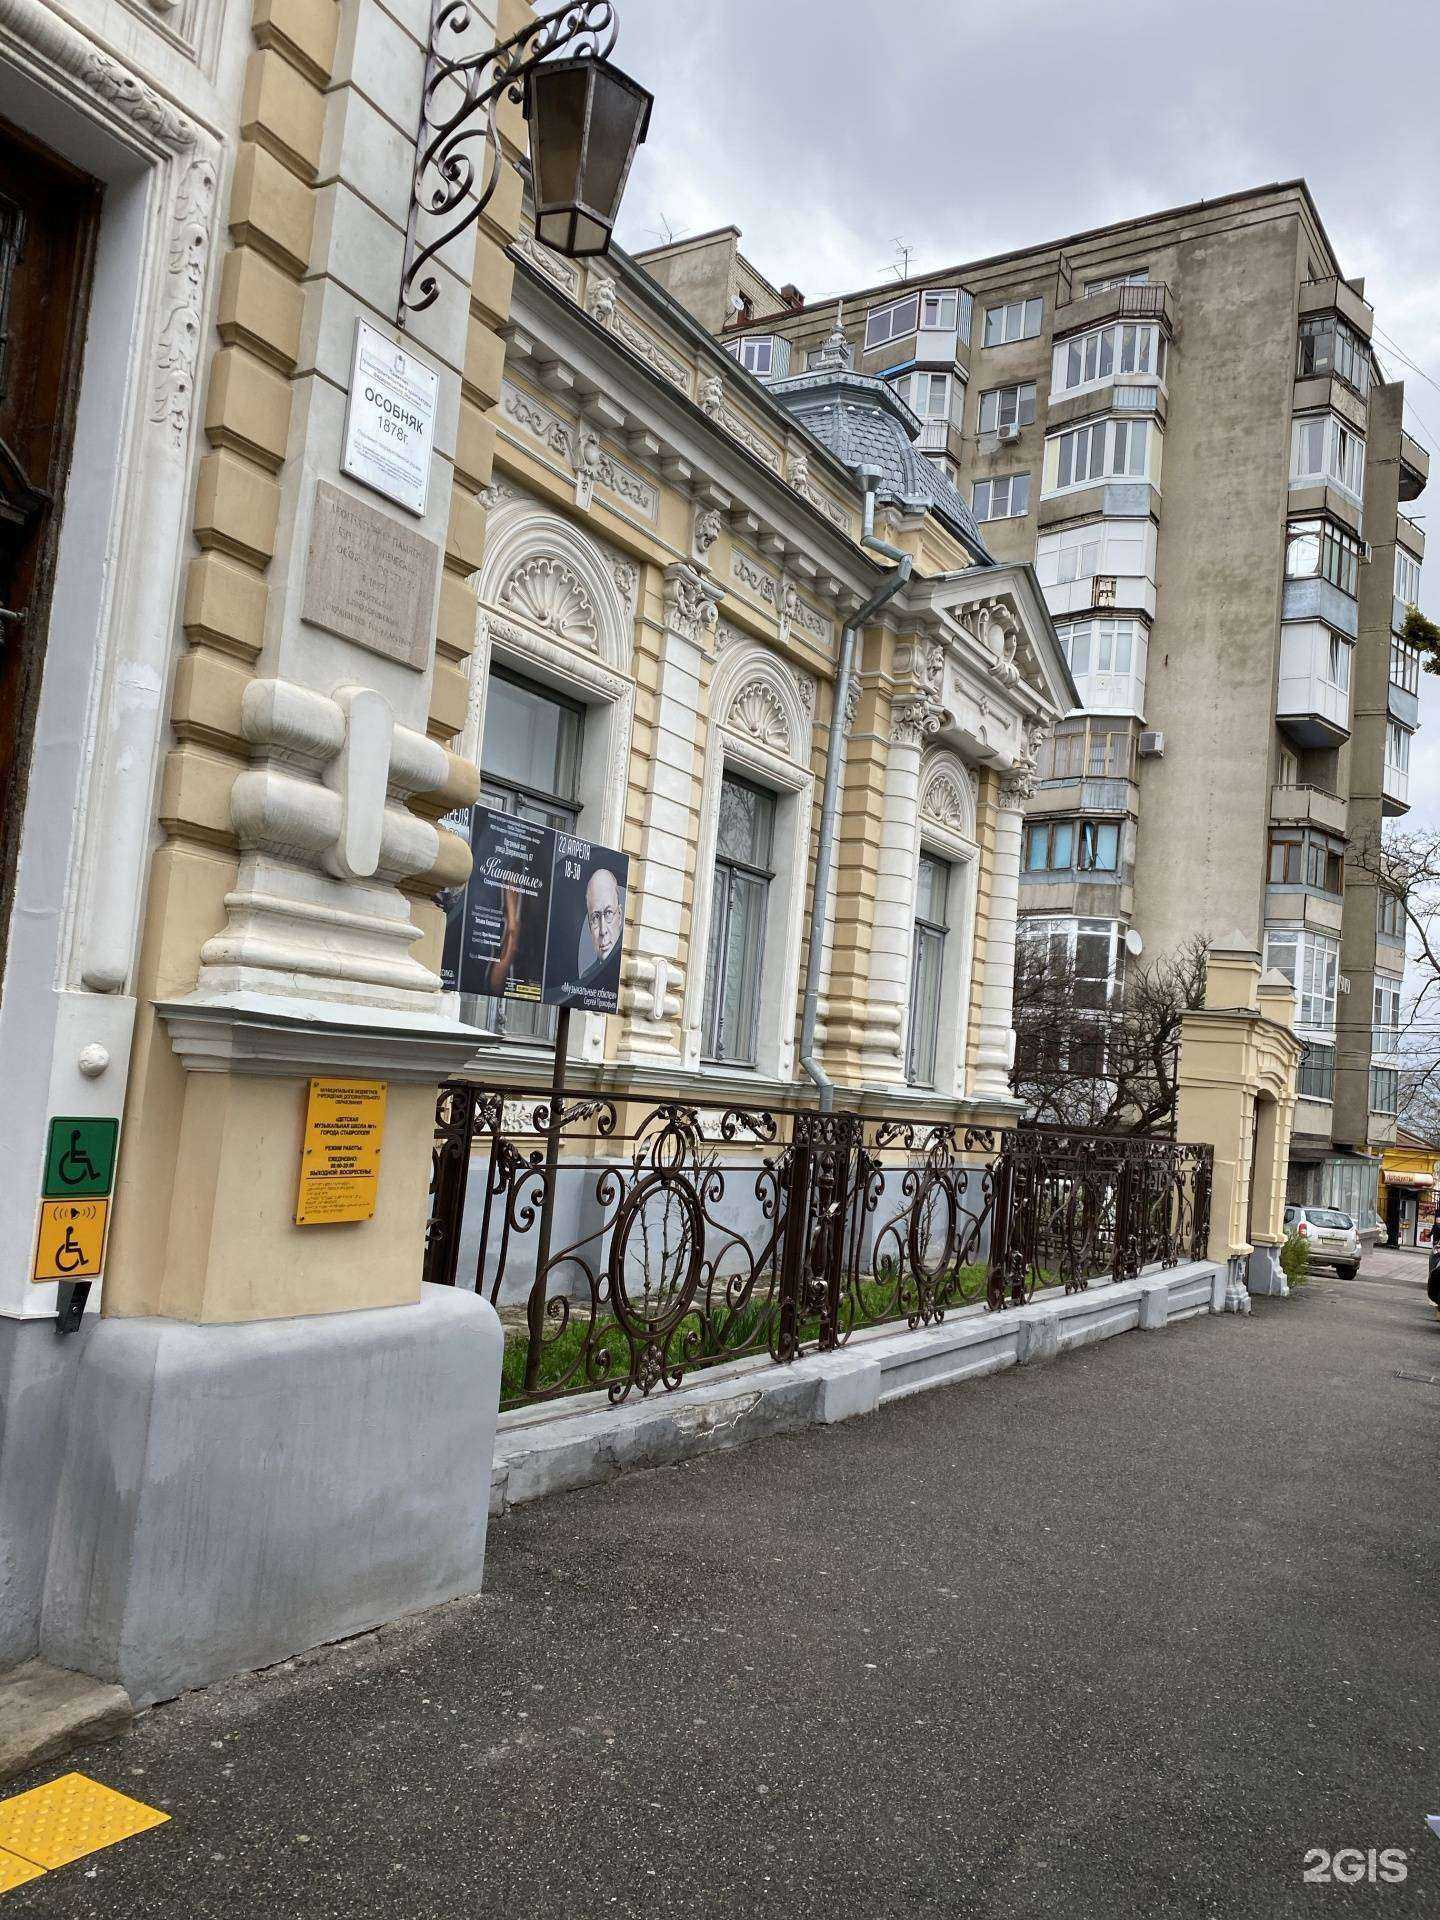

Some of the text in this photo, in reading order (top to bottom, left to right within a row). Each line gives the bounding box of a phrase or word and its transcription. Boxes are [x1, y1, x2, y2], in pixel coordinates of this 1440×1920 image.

[364, 387, 424, 435] ОСОБНЯК
[378, 416, 409, 445] 1878г.
[558, 835, 591, 861] 22 АПРЕЛЯ
[564, 859, 581, 881] 18-30
